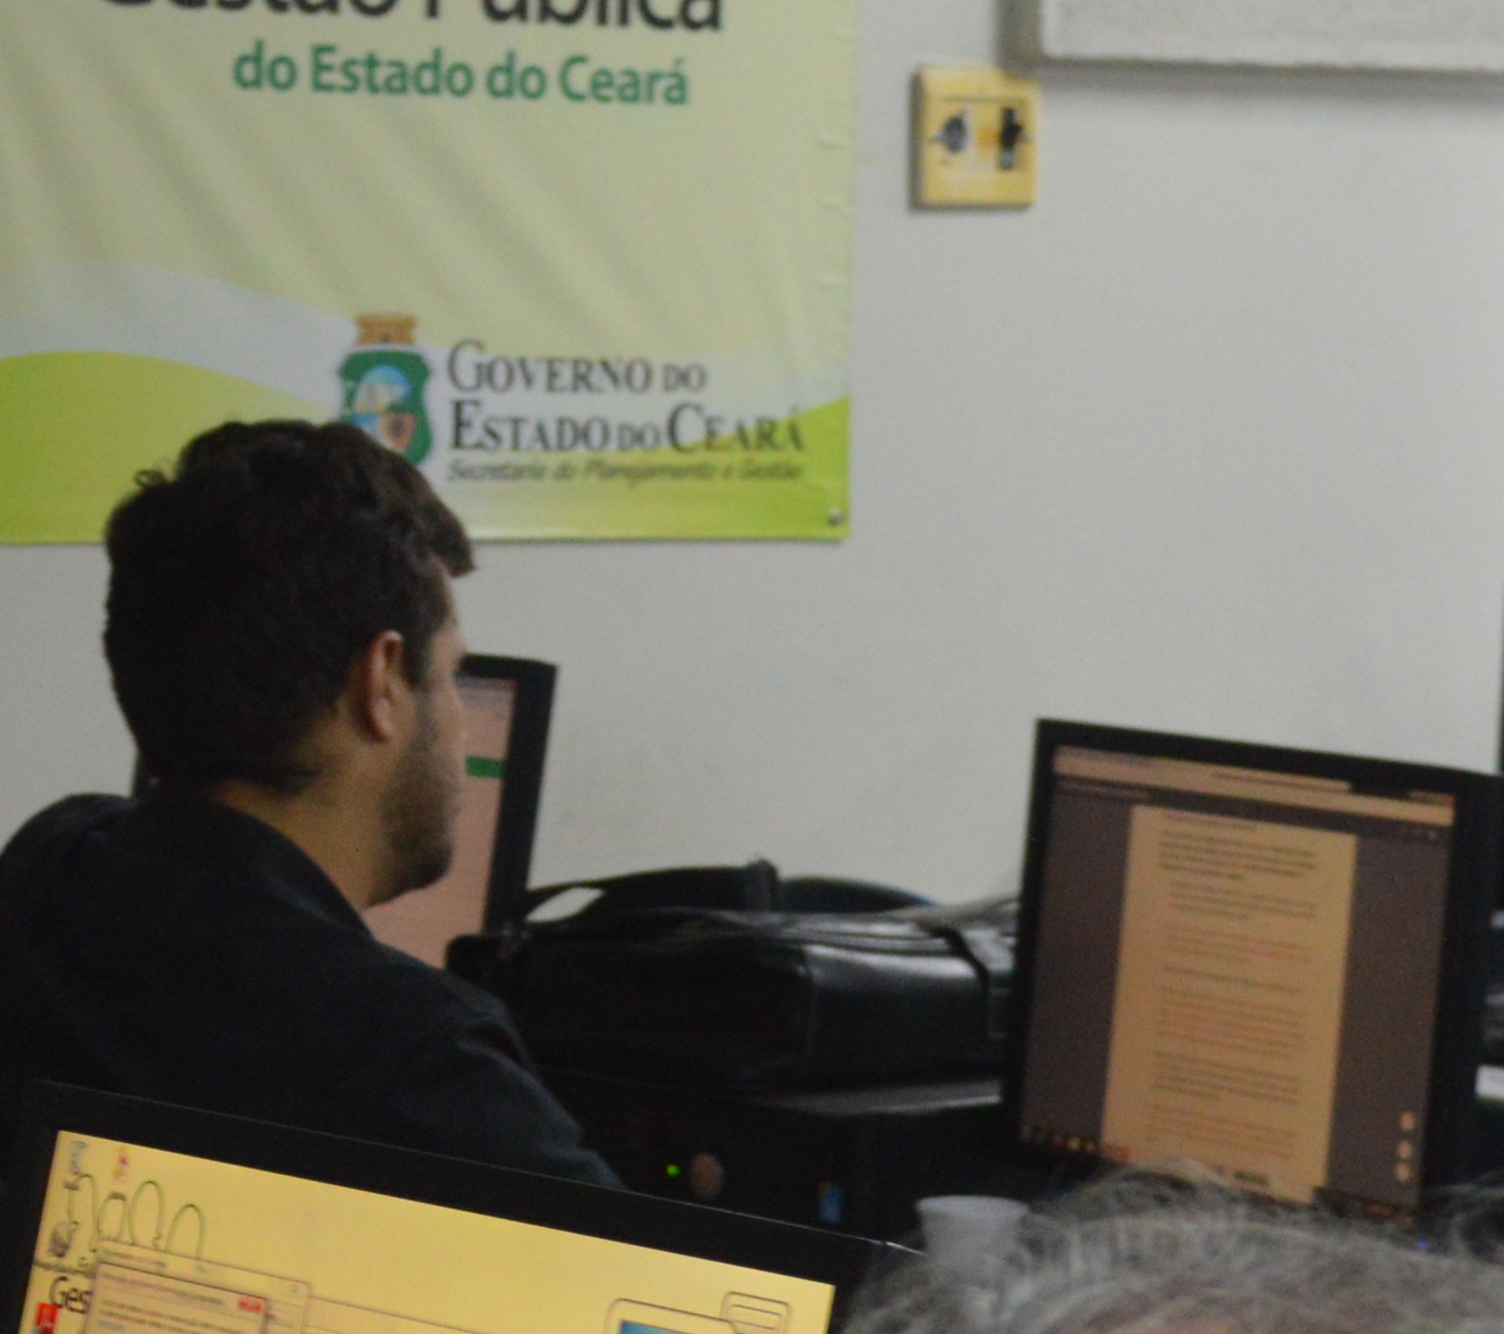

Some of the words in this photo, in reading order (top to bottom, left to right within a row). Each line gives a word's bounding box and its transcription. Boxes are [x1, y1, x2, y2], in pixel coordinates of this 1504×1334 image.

[233, 38, 298, 91] do
[310, 43, 475, 97] Estado
[486, 49, 547, 100] do
[559, 54, 690, 105] Ceará
[447, 338, 654, 394] GOVERNO
[662, 364, 708, 392] DO
[449, 398, 612, 452] ESTADO
[617, 420, 662, 451] DO
[49, 1275, 93, 1315] Ges
